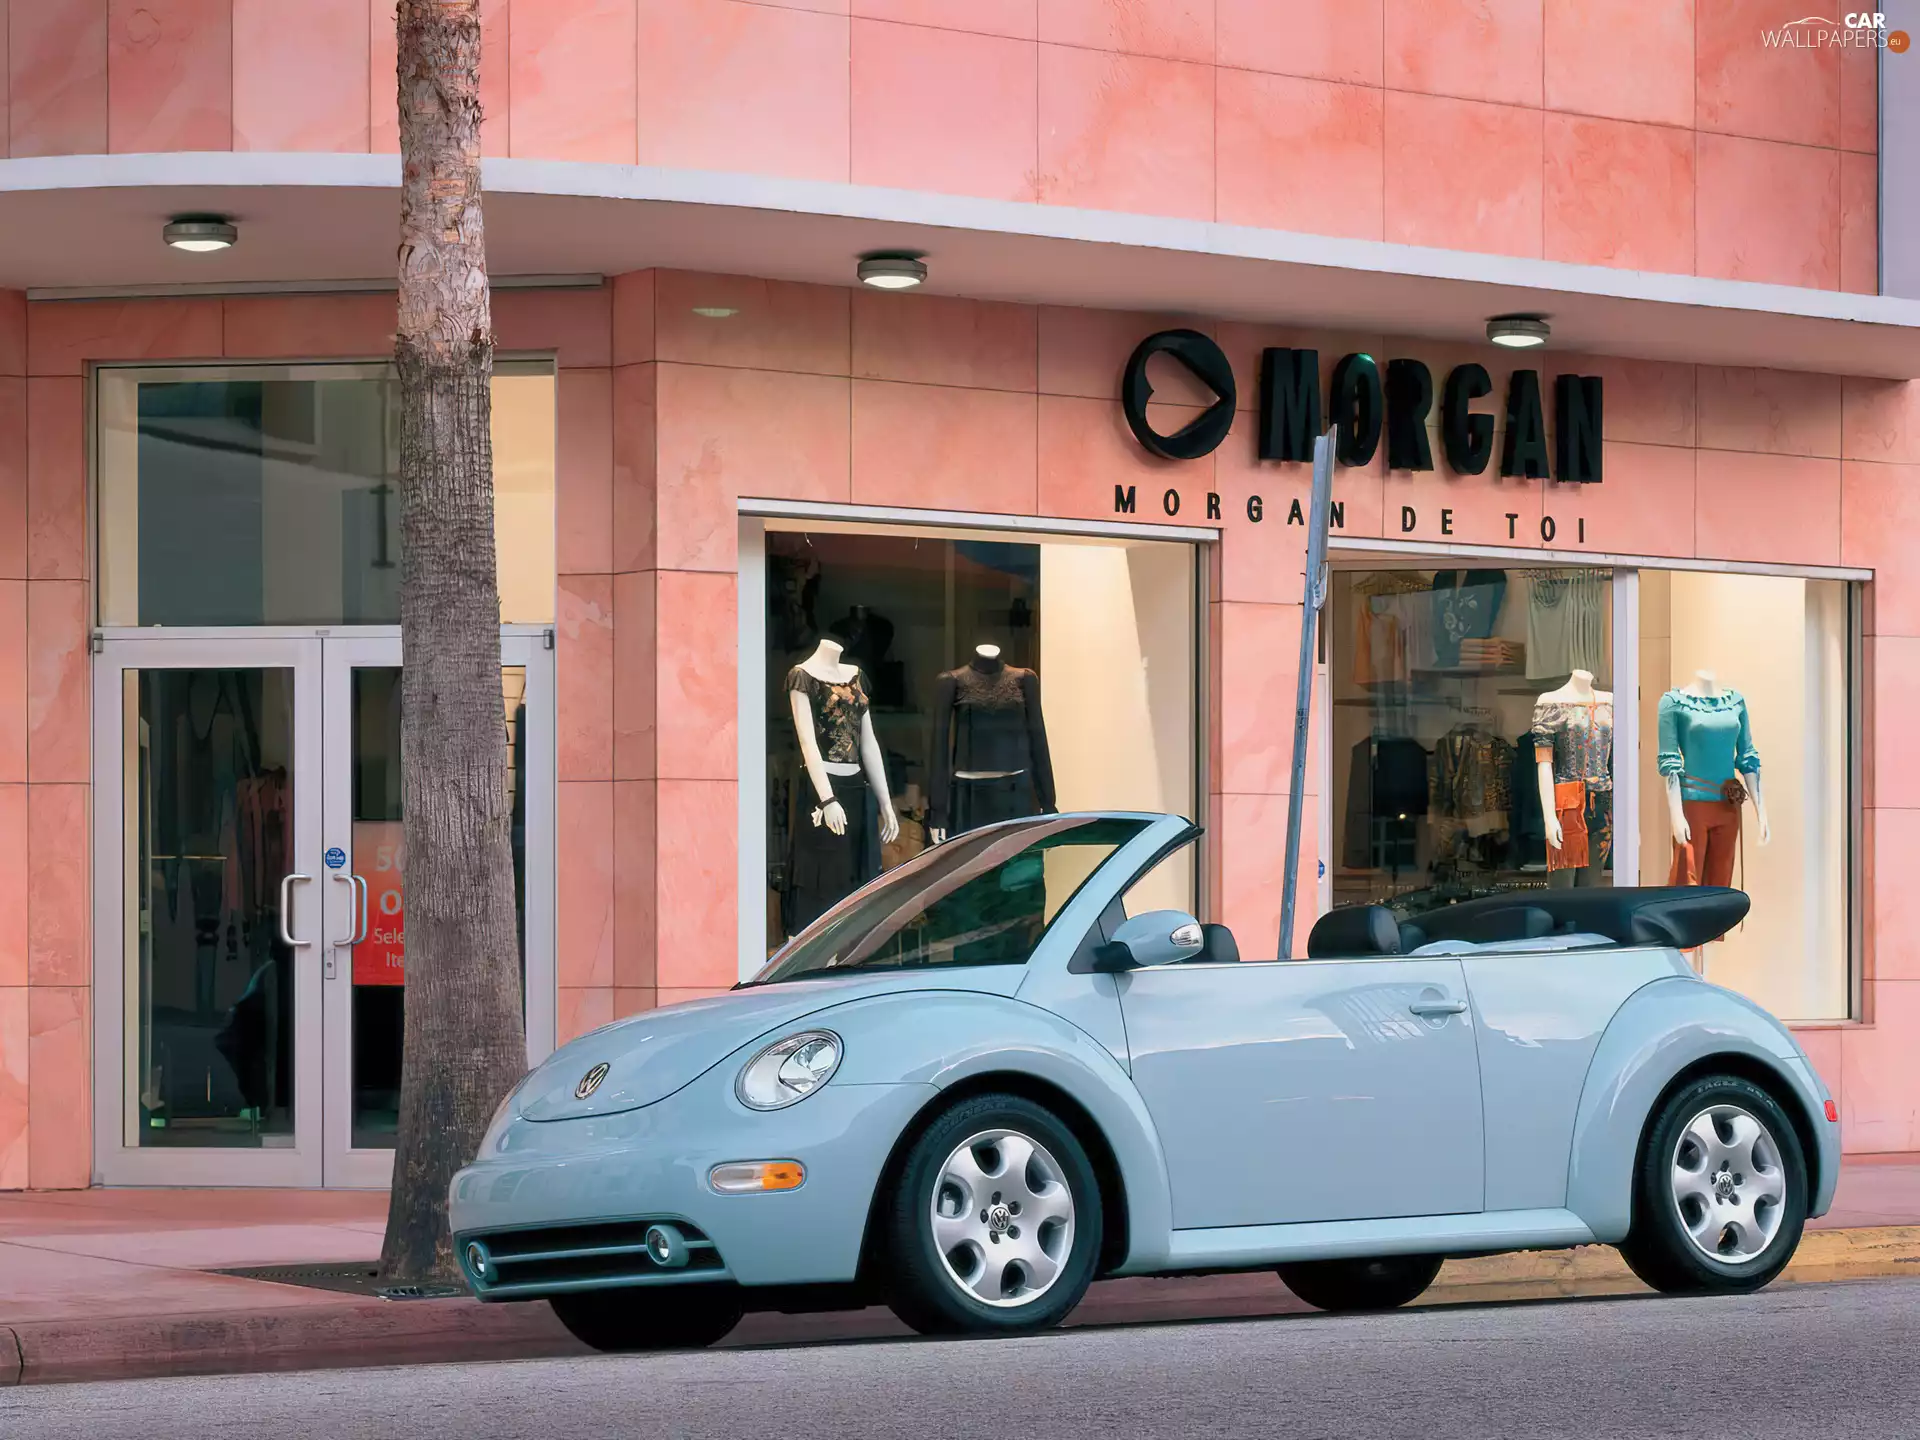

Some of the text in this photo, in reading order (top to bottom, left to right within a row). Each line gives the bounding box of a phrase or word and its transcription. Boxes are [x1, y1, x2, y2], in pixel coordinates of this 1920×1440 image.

[1257, 347, 1604, 484] MORGAN
[1113, 484, 1585, 544] MORGAN DE TOI
